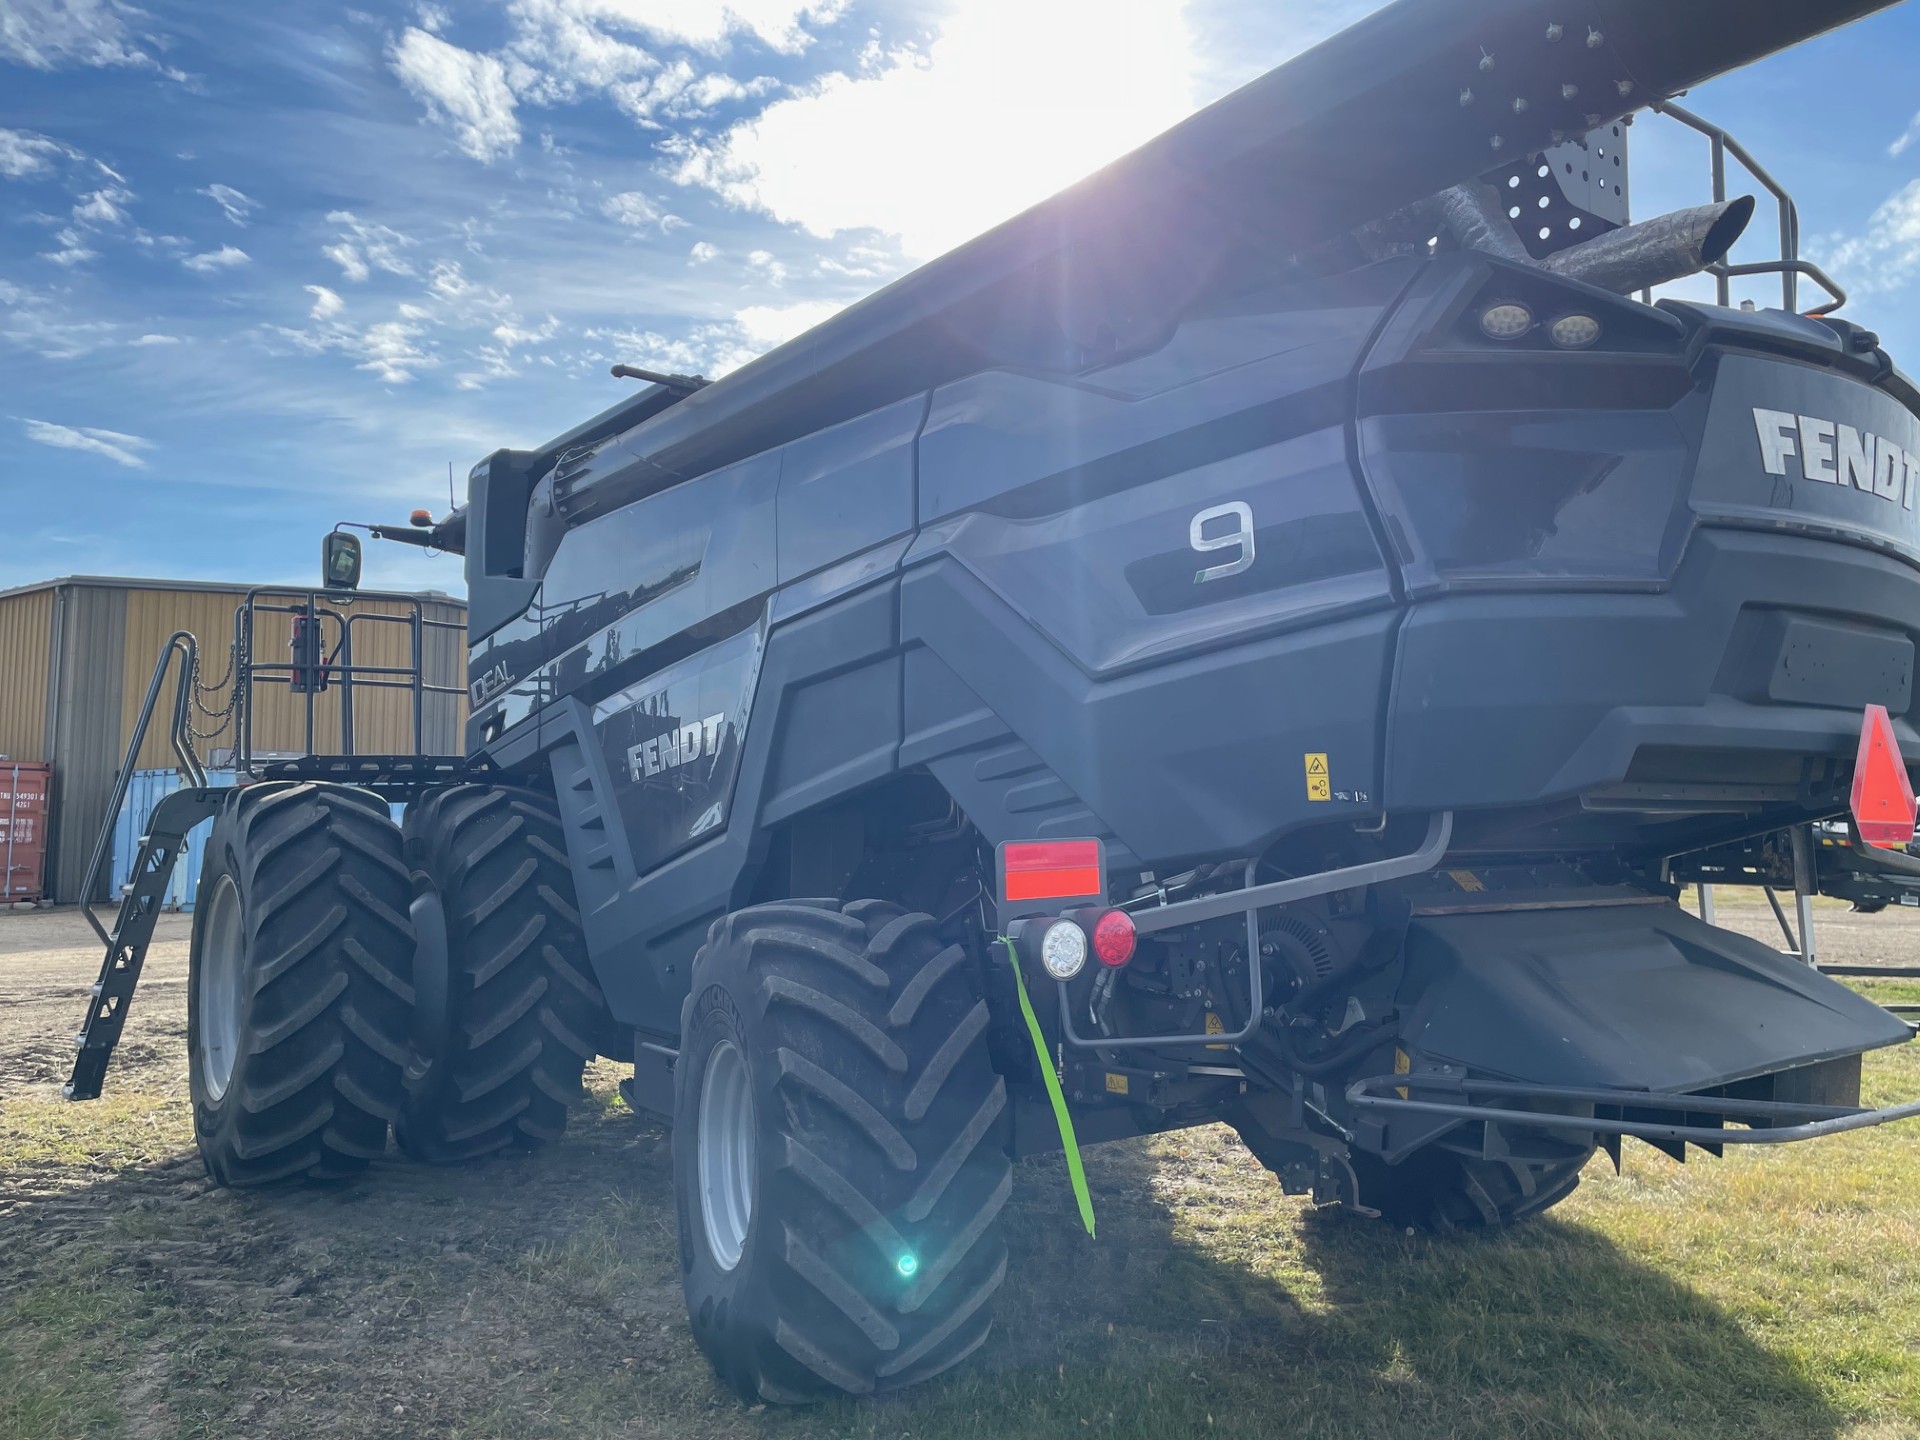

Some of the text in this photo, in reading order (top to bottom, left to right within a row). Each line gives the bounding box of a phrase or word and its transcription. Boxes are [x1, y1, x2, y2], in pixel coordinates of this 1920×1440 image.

[1752, 408, 1920, 511] FENDT
[1190, 501, 1255, 584] 9
[470, 660, 515, 707] IDEAL
[627, 712, 725, 782] FENDT
